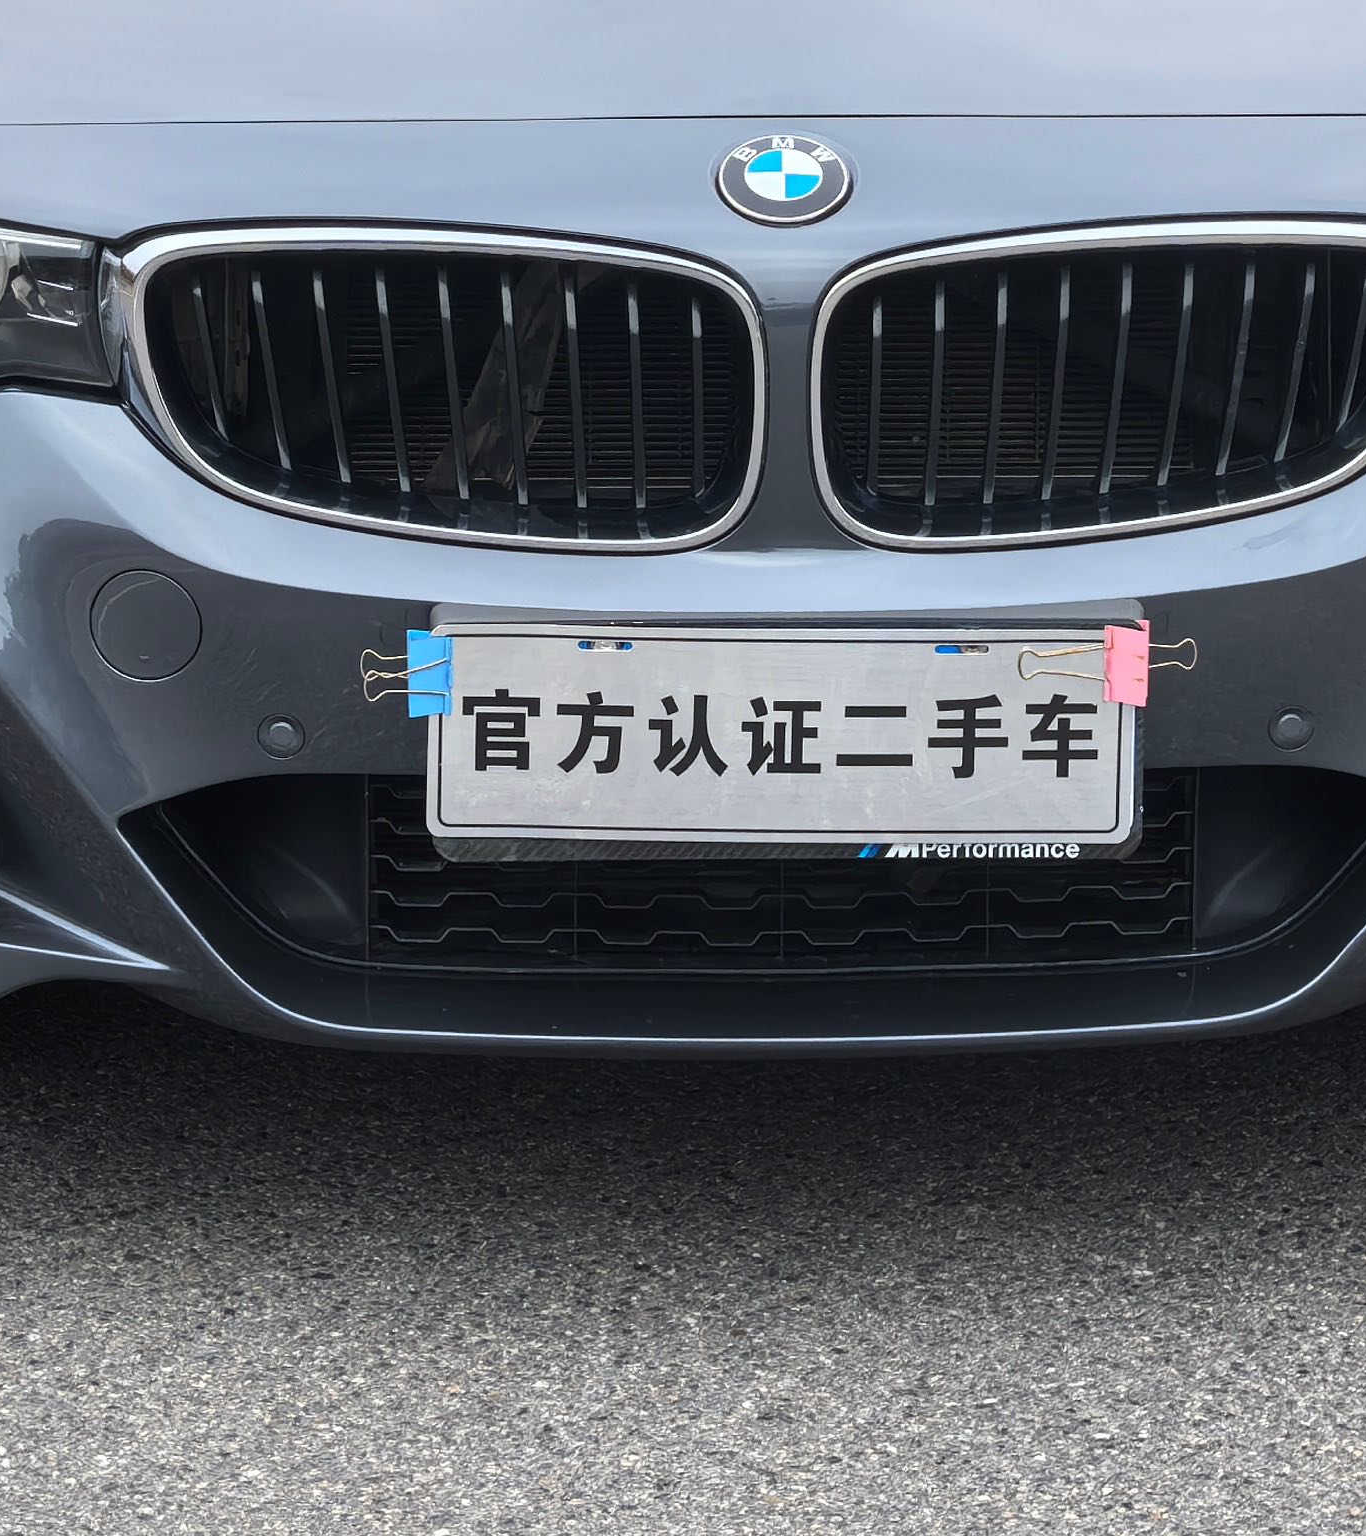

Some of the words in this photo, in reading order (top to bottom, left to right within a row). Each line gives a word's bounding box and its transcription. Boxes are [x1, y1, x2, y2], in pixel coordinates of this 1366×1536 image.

[731, 136, 836, 163] BMW
[461, 688, 1100, 779] 官方认证二手车
